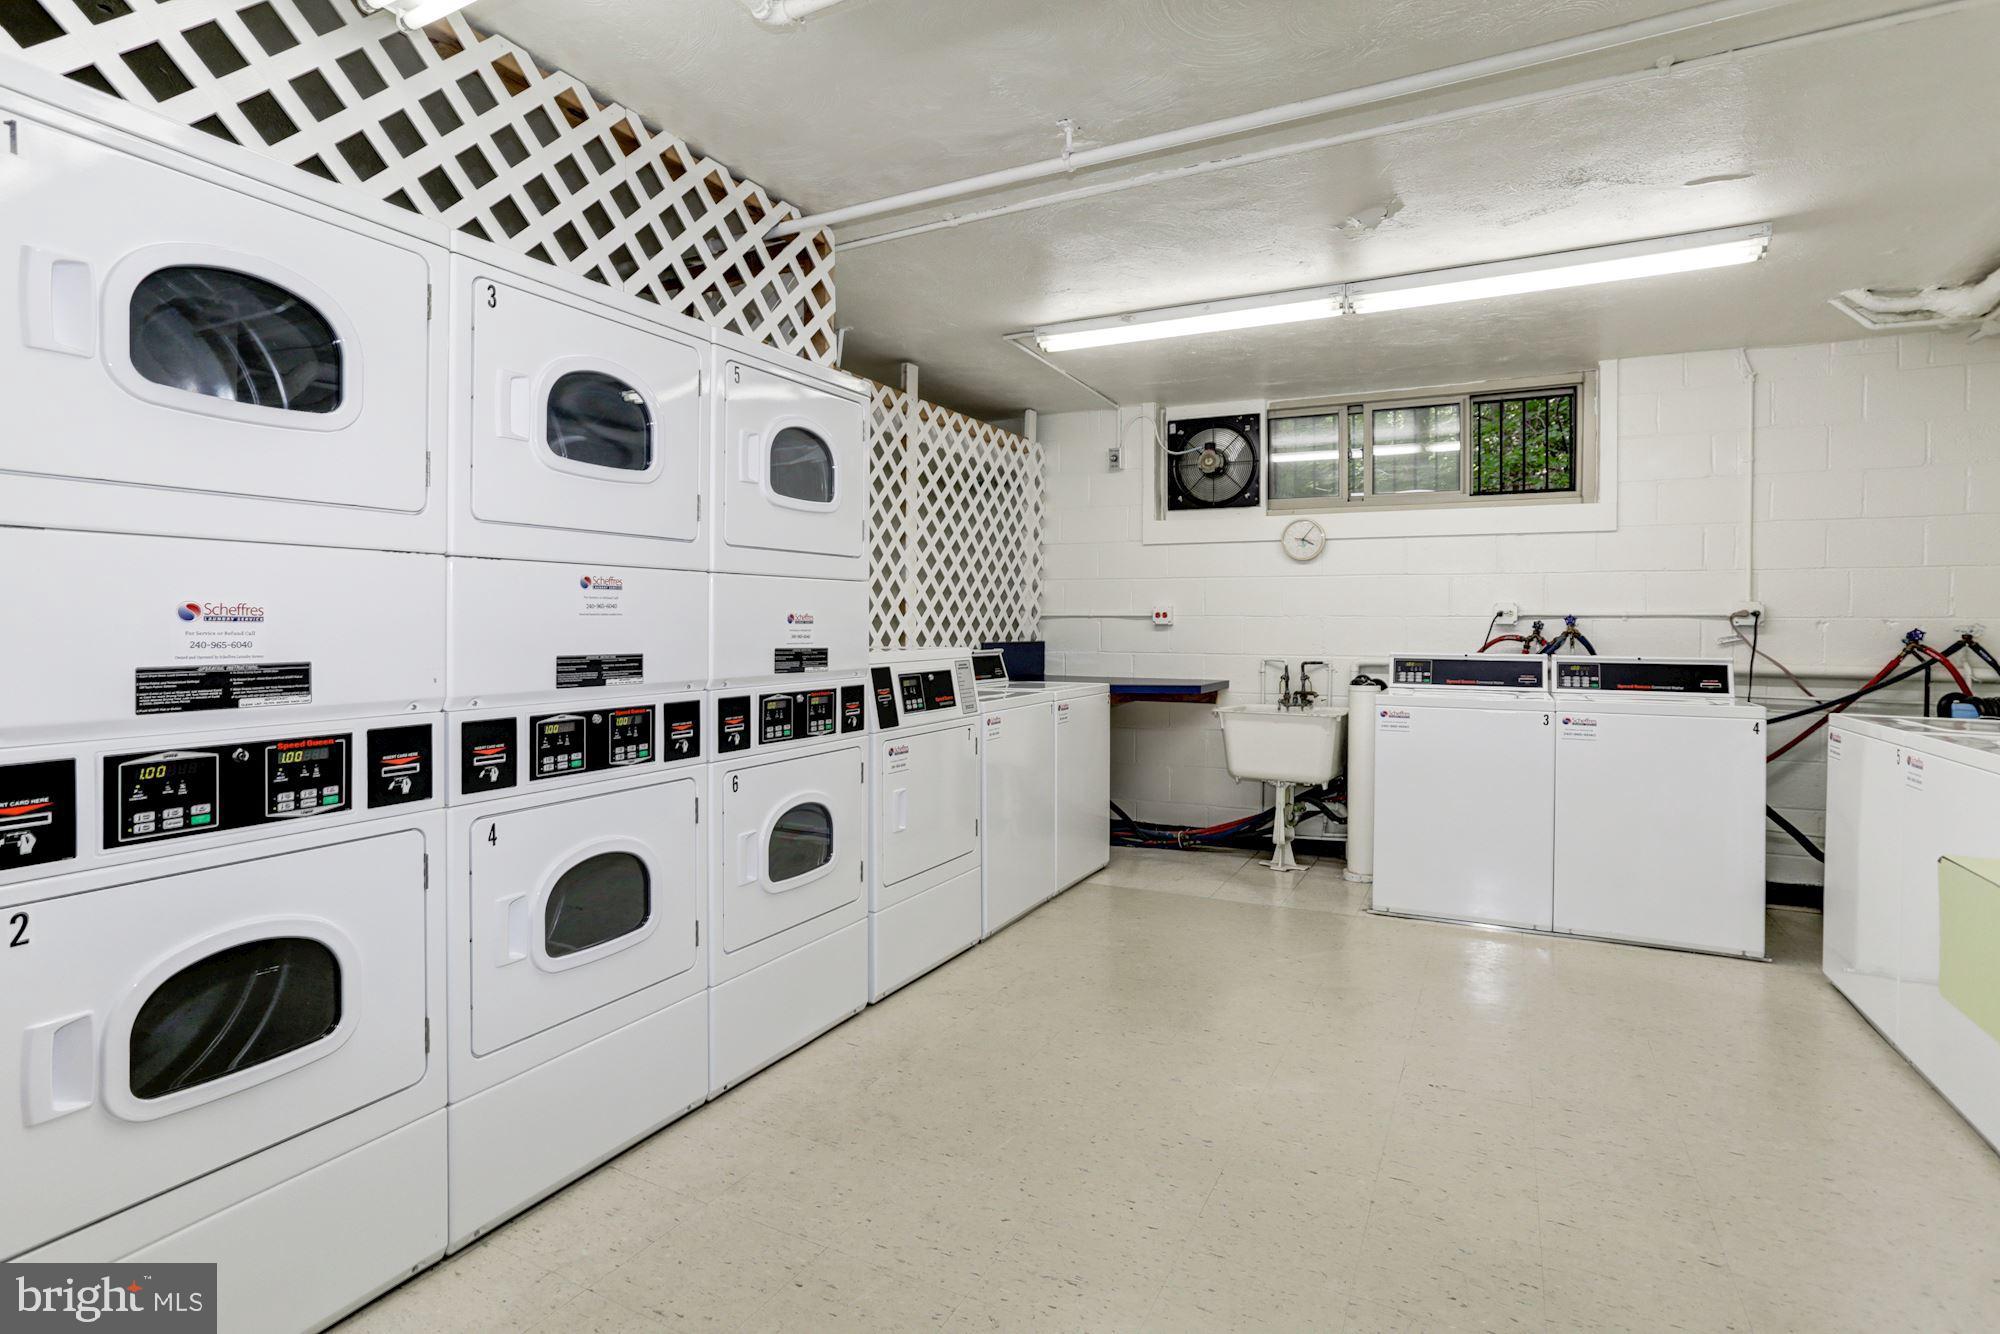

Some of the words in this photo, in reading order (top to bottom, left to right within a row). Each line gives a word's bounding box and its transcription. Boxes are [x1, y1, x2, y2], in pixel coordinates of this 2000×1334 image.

[3, 119, 18, 155] 1
[487, 284, 497, 309] 3
[734, 365, 740, 384] 5
[592, 575, 623, 586] Scheffres
[203, 602, 264, 616] Scheffres
[189, 640, 253, 649] 240-965-6040
[1543, 714, 1549, 726] 3
[1752, 722, 1760, 735] 4
[277, 741, 306, 751] Speed
[306, 738, 335, 747] Queen
[140, 765, 166, 780] 1.00
[732, 775, 739, 793] 6
[10, 799, 30, 807] CARD
[30, 796, 50, 805] HERE
[487, 822, 498, 847] 4
[9, 911, 30, 948] 2
